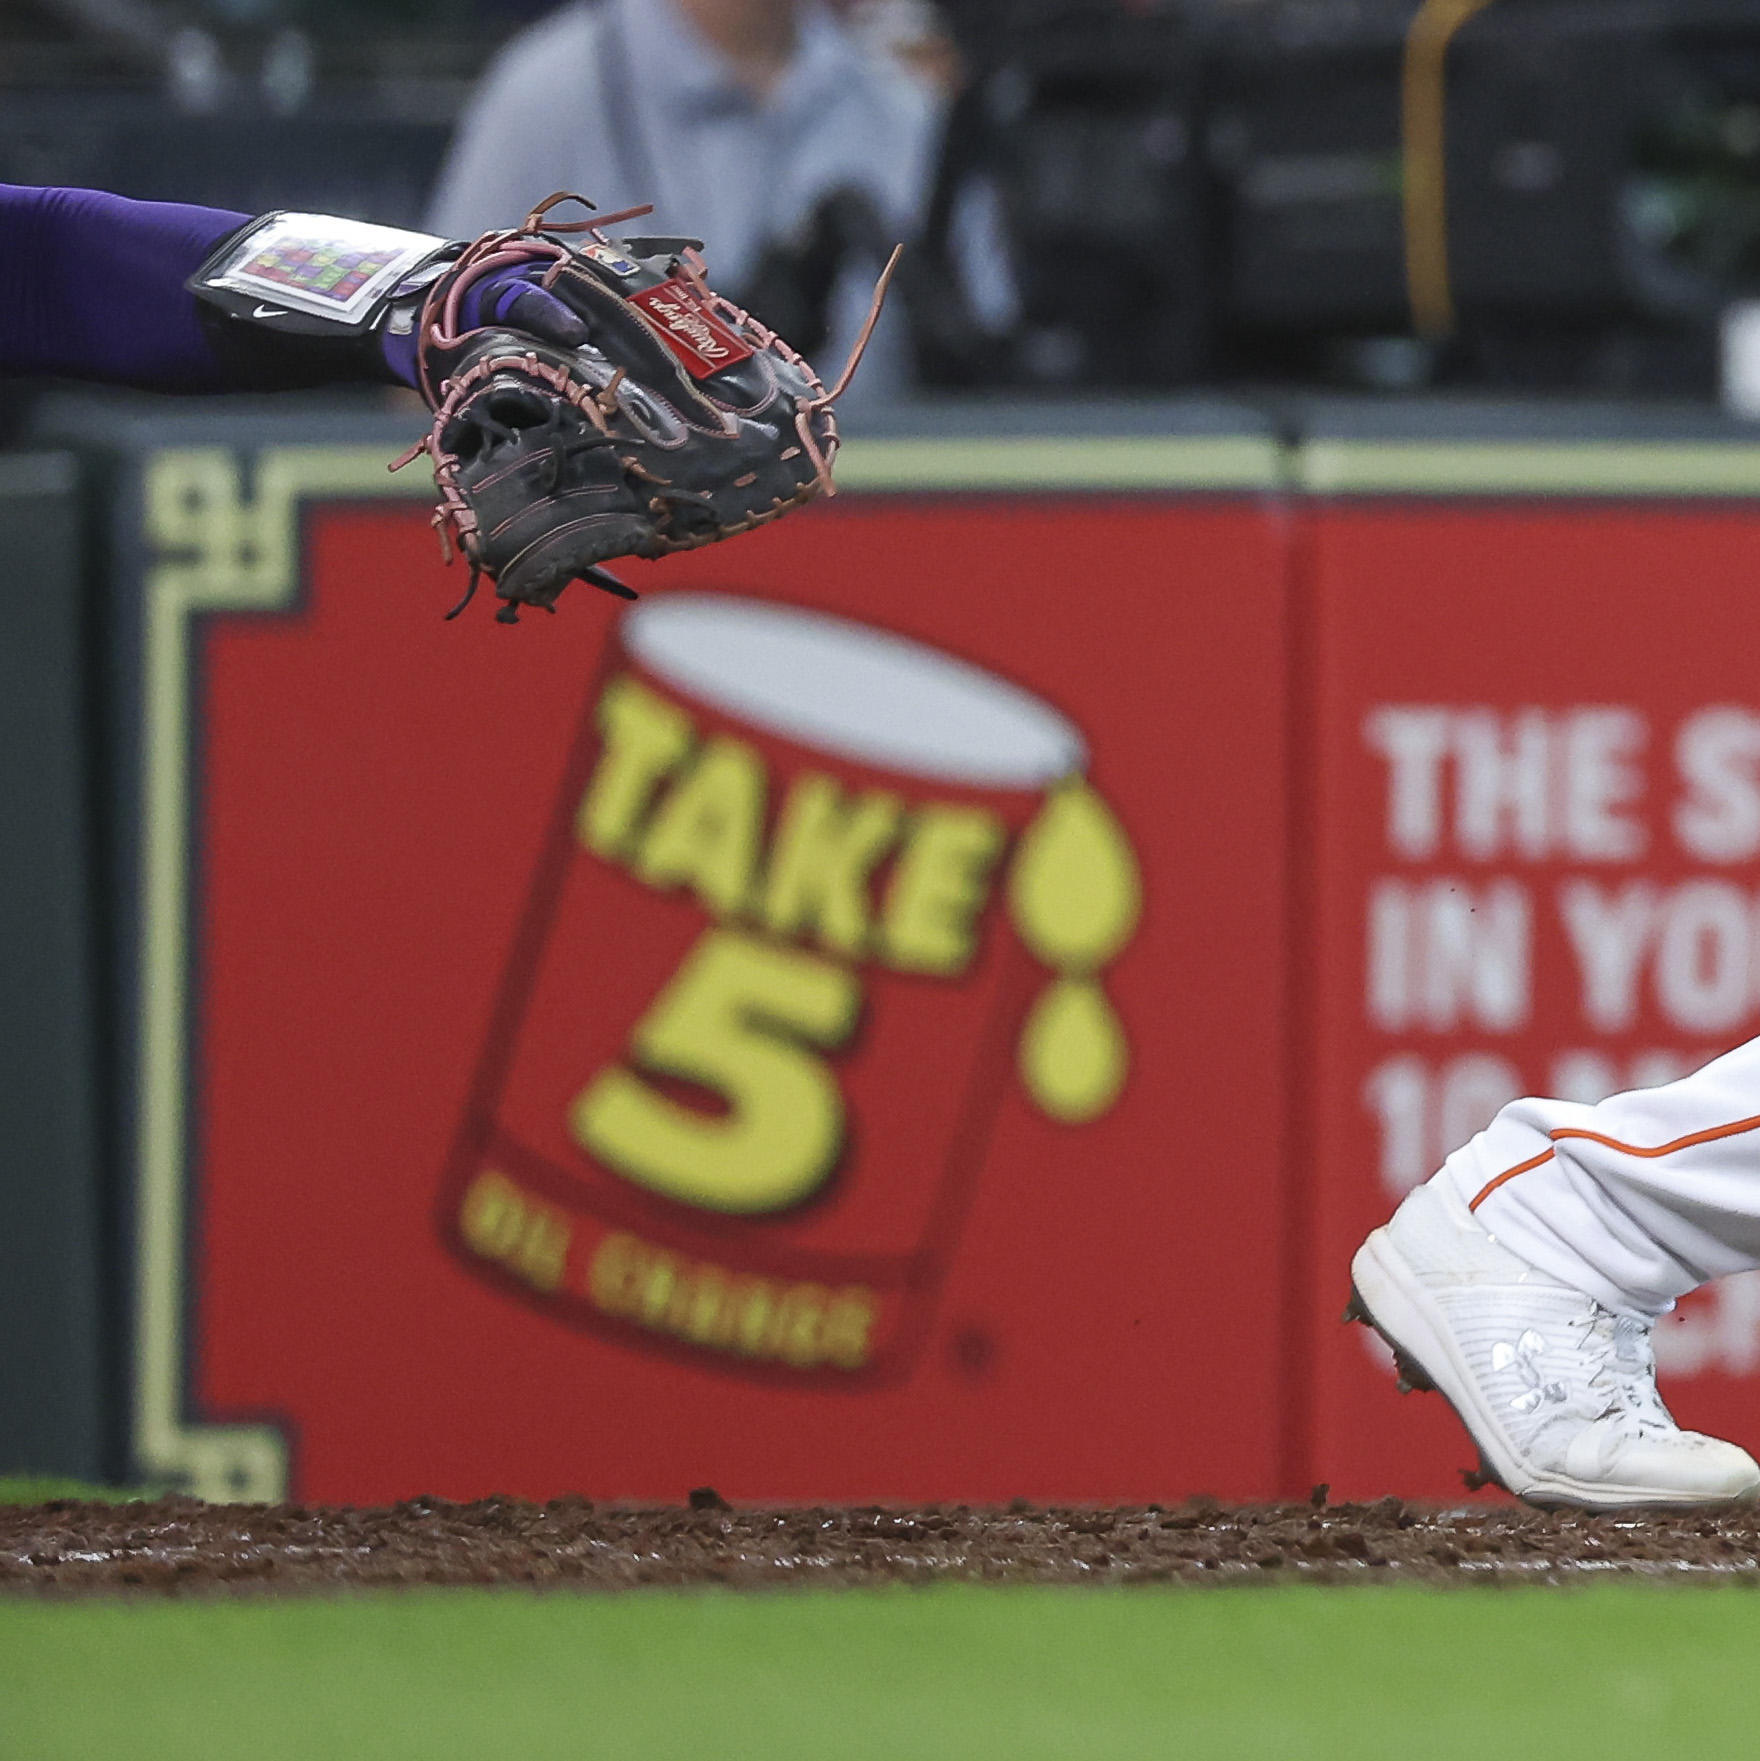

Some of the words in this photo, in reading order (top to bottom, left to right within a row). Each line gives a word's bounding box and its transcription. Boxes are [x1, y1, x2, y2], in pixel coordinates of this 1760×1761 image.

[578, 674, 1002, 978] TAKE
[1368, 708, 1645, 859] THE
[1368, 880, 1530, 1032] IN
[570, 925, 866, 1212] 5
[460, 1166, 571, 1292] OIL
[587, 1232, 878, 1370] CHANGE
